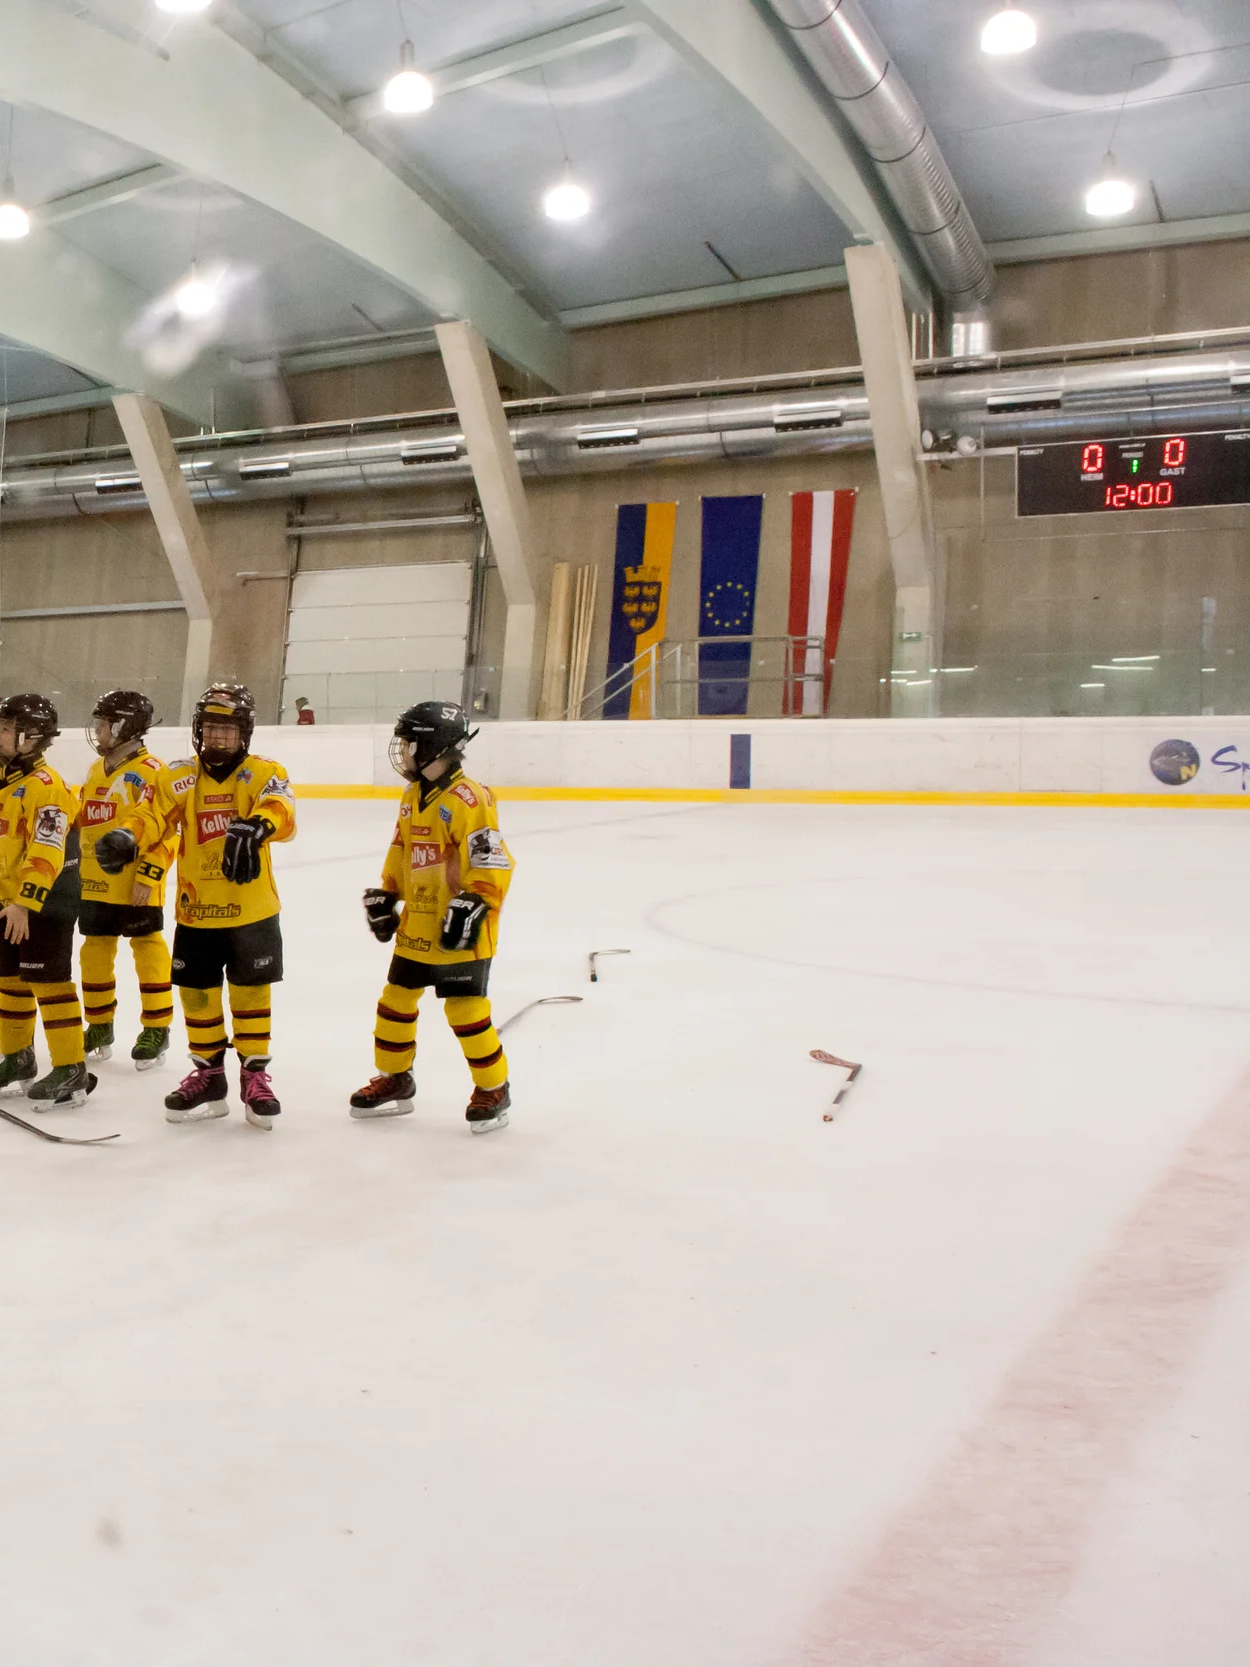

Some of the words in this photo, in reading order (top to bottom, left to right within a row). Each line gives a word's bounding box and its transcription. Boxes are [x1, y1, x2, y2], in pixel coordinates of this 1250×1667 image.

[1083, 444, 1103, 472] 0
[1164, 438, 1185, 466] 0
[1131, 459, 1139, 474] 1
[1160, 466, 1185, 476] GAST
[1080, 472, 1104, 482] HEIM
[1105, 481, 1173, 507] 12:00
[440, 707, 458, 721] 57
[19, 881, 51, 904] 80
